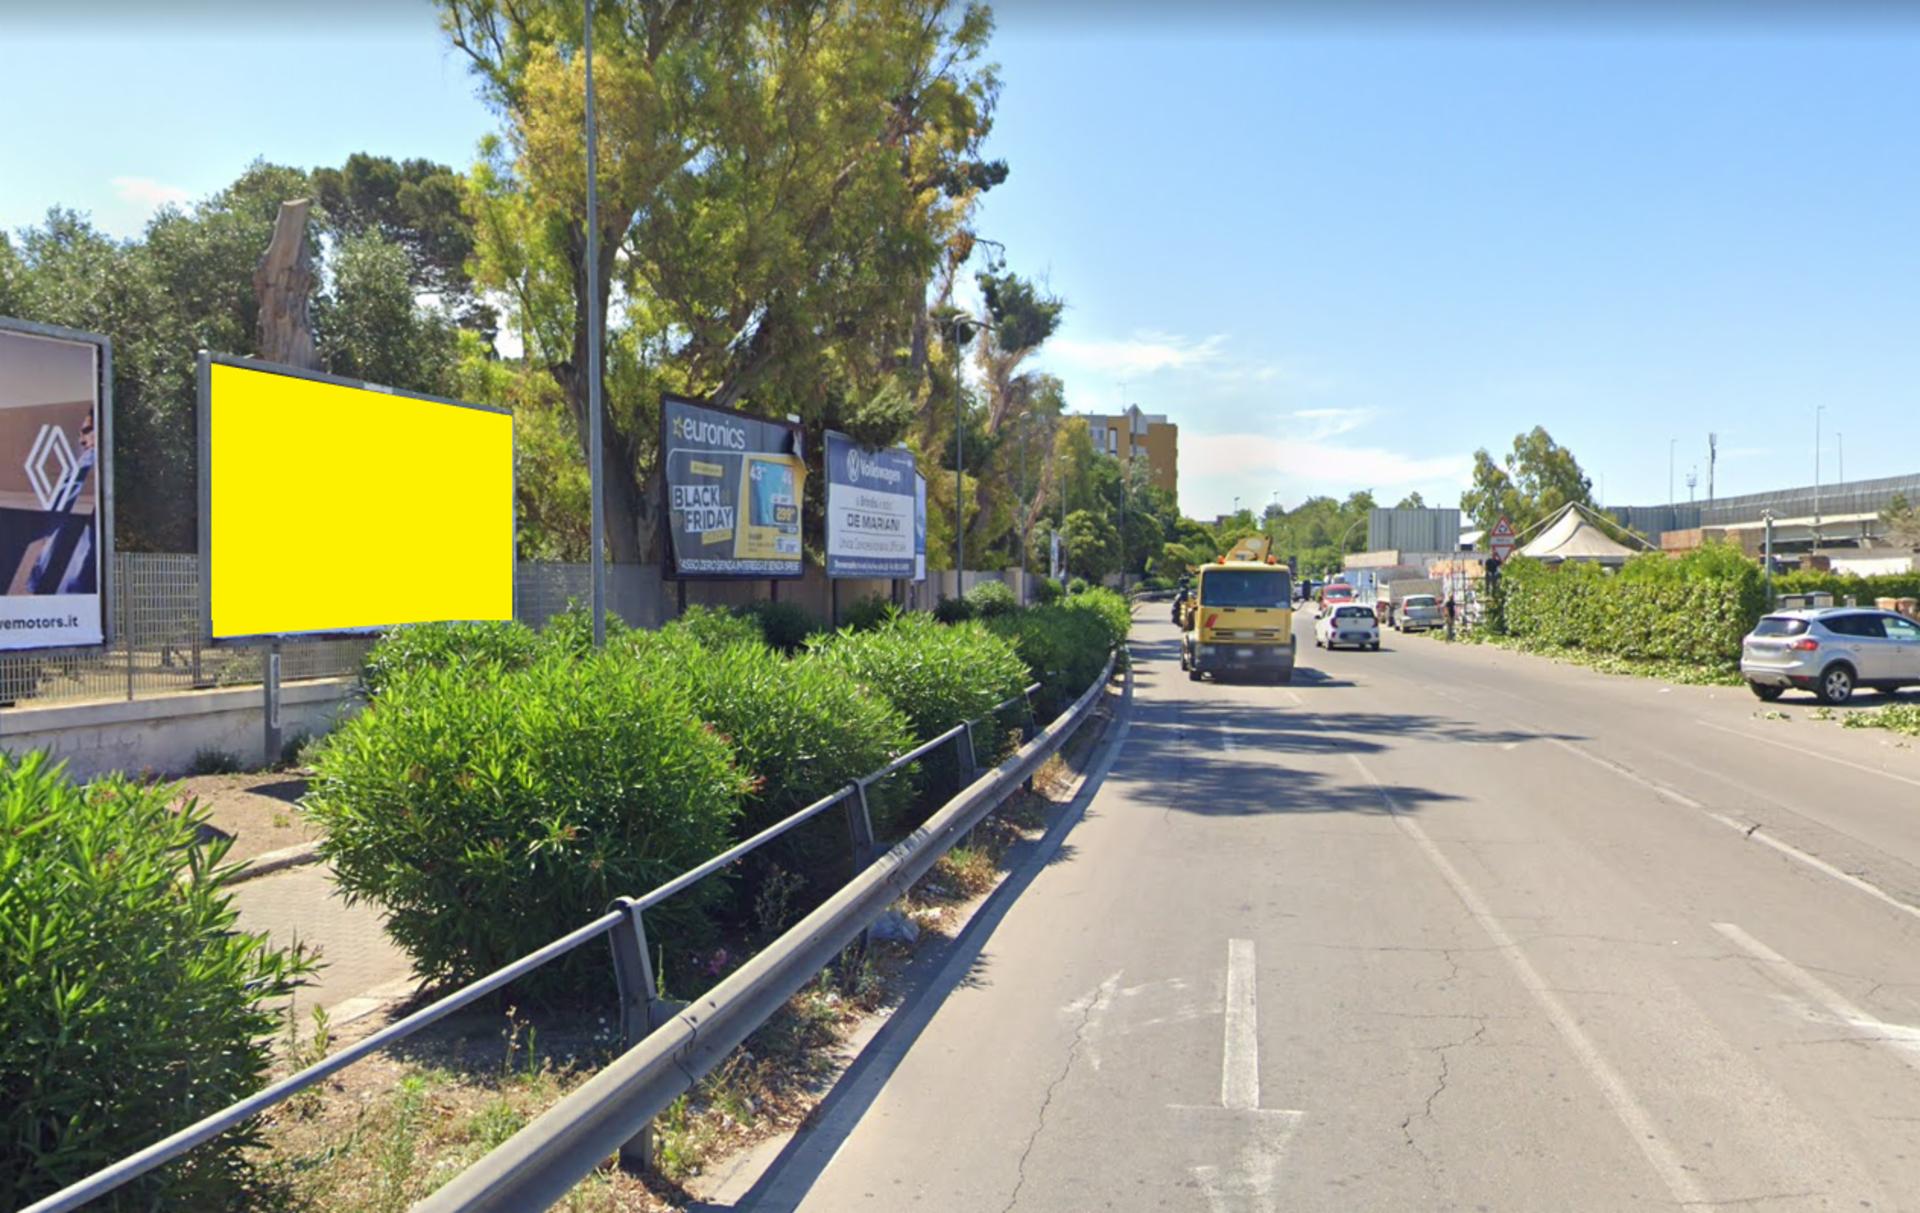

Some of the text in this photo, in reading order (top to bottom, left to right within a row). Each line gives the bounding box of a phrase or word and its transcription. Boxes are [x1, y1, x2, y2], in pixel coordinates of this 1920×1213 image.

[683, 418, 745, 450] euronics
[674, 487, 719, 507] BLACK
[686, 508, 733, 531] FRIDAY
[847, 513, 861, 528] DE
